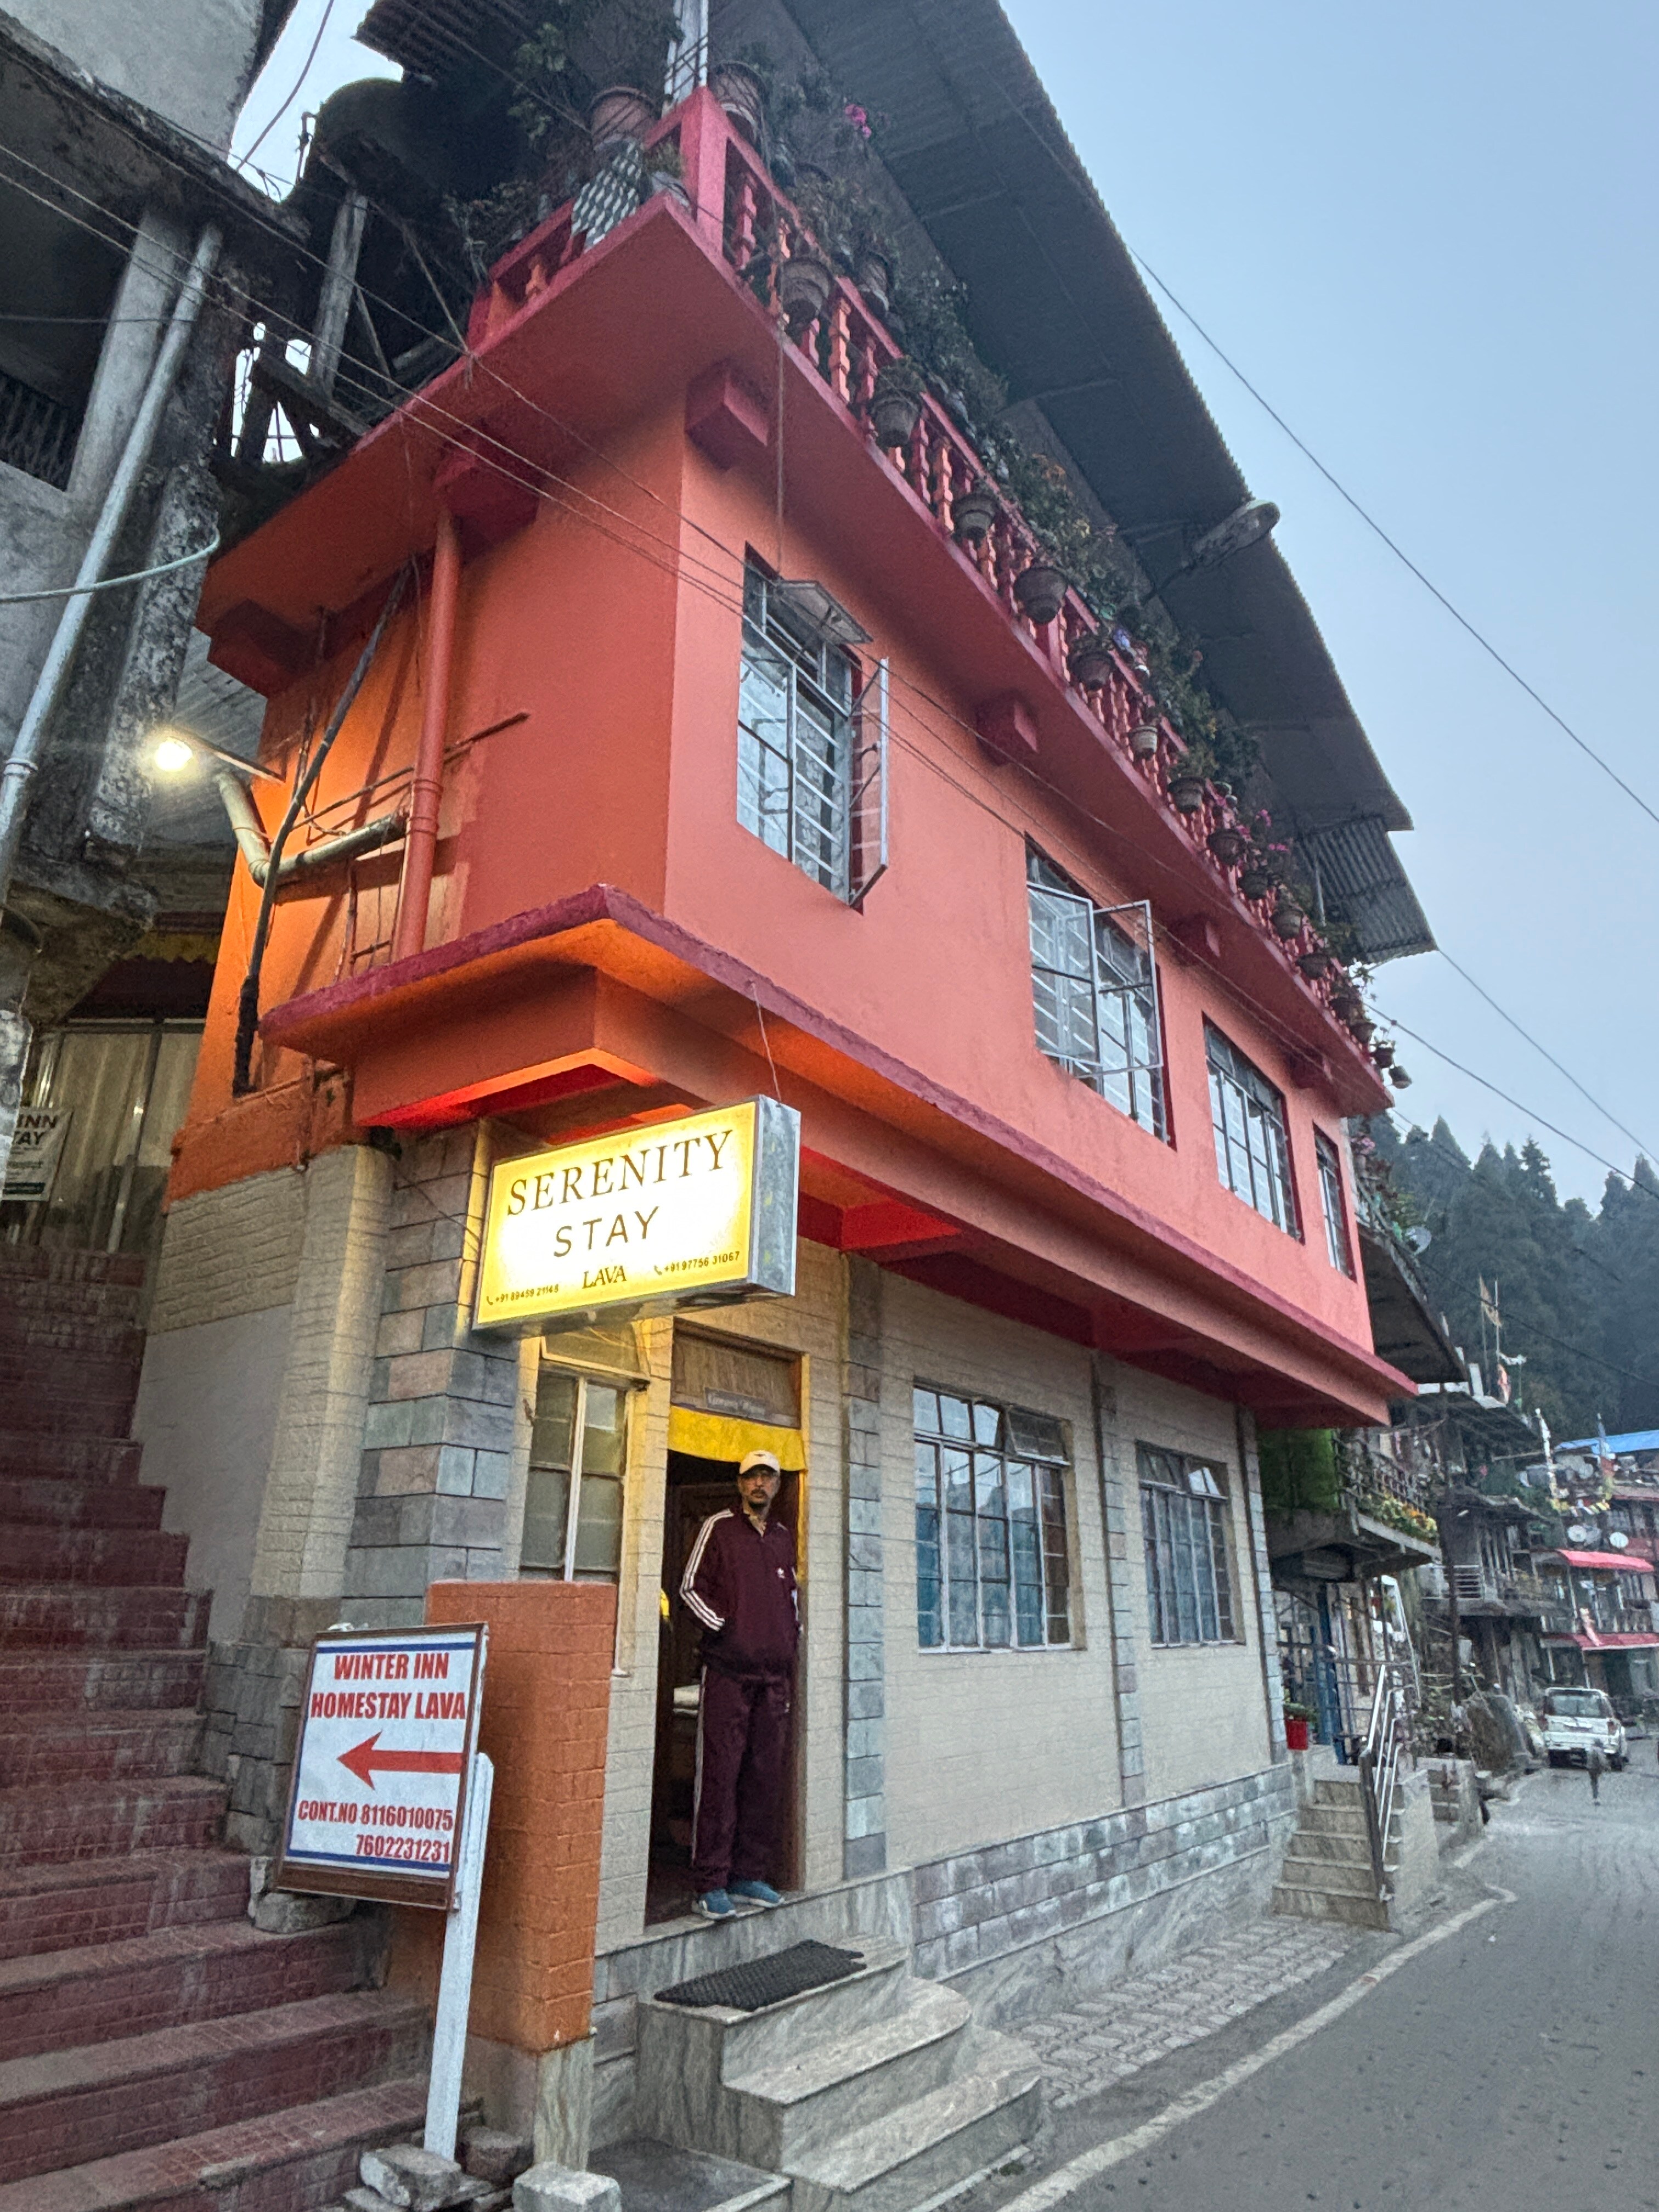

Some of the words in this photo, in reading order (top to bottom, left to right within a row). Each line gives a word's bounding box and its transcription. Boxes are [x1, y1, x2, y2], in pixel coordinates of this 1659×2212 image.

[16, 1114, 58, 1128] INN
[507, 1129, 733, 1216] SERENITY
[554, 1206, 659, 1257] STAY
[582, 1265, 627, 1289] LAVA
[334, 1654, 409, 1680] WINTER
[413, 1652, 449, 1679] INN
[310, 1692, 411, 1719] HOMESTAY
[414, 1692, 466, 1719] LAVA
[360, 1804, 453, 1831] 8116010075
[356, 1834, 450, 1863] 7602231231
